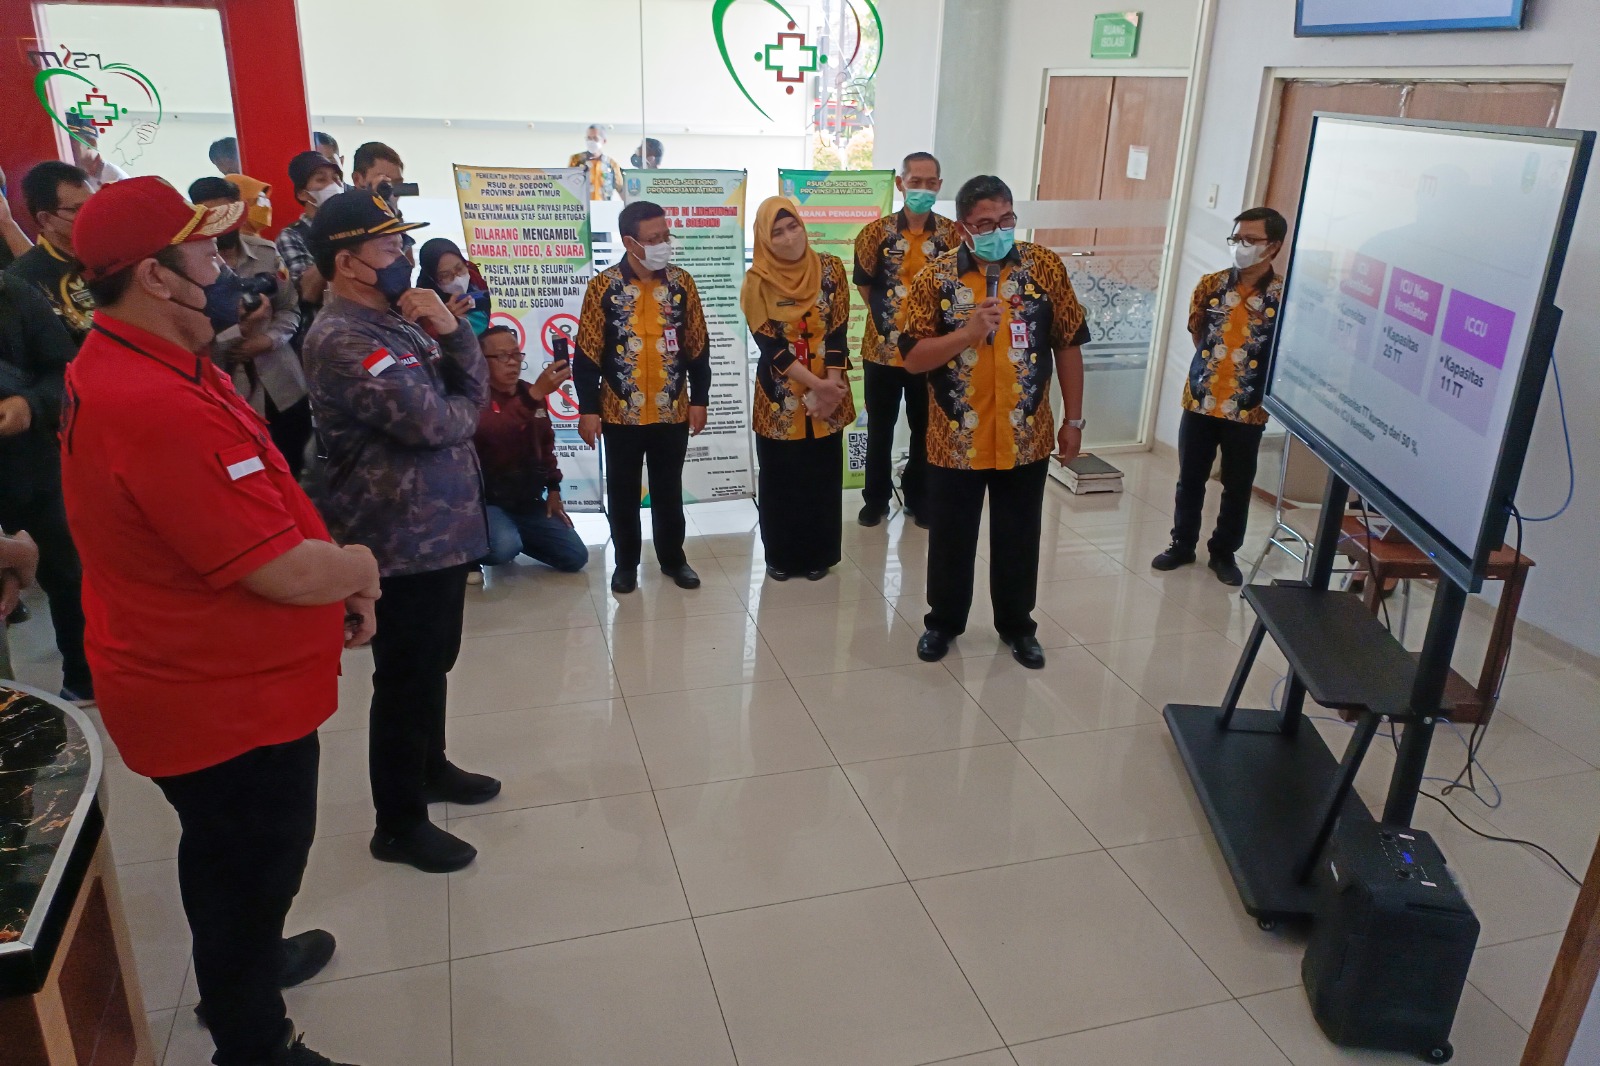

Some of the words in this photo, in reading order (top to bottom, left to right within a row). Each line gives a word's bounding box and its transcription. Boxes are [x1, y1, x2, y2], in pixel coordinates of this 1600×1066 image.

[478, 212, 519, 220] KENYAMANAN
[686, 218, 720, 227] SOEDONO
[474, 228, 518, 240] DILARANG
[522, 228, 577, 240] MENGAMBIL
[470, 244, 510, 258] GAMBAR,
[513, 244, 542, 258] VIDEO,
[546, 245, 552, 256] &
[555, 245, 584, 256] SUARA
[484, 264, 512, 275] PASIEN,
[514, 264, 530, 274] STAF
[533, 264, 538, 274] &
[541, 264, 574, 274] SELURUH
[490, 275, 529, 286] PELAYANAN
[532, 276, 539, 285] DI
[542, 276, 568, 285] RUMAH
[570, 275, 589, 285] SAKIT
[490, 287, 502, 297] NPA
[505, 287, 519, 297] ADA
[522, 287, 535, 297] IZIN
[538, 287, 560, 297] RESMI
[563, 286, 579, 296] DARI
[1400, 279, 1413, 295] ICU
[1413, 285, 1429, 301] Non
[498, 299, 517, 308] RSUD
[520, 299, 528, 308] dr.
[531, 298, 564, 308] SOEDONO
[1394, 296, 1428, 322] Ventilator
[1464, 316, 1488, 338] ICCU
[1386, 327, 1419, 353] Kapasitas
[1383, 344, 1392, 359] 25
[1393, 348, 1402, 364] TT
[1444, 355, 1484, 388] Kapasitas
[1441, 375, 1451, 392] 11
[1453, 381, 1463, 398] TT
[1388, 425, 1401, 442] dari
[1401, 434, 1410, 448] 50
